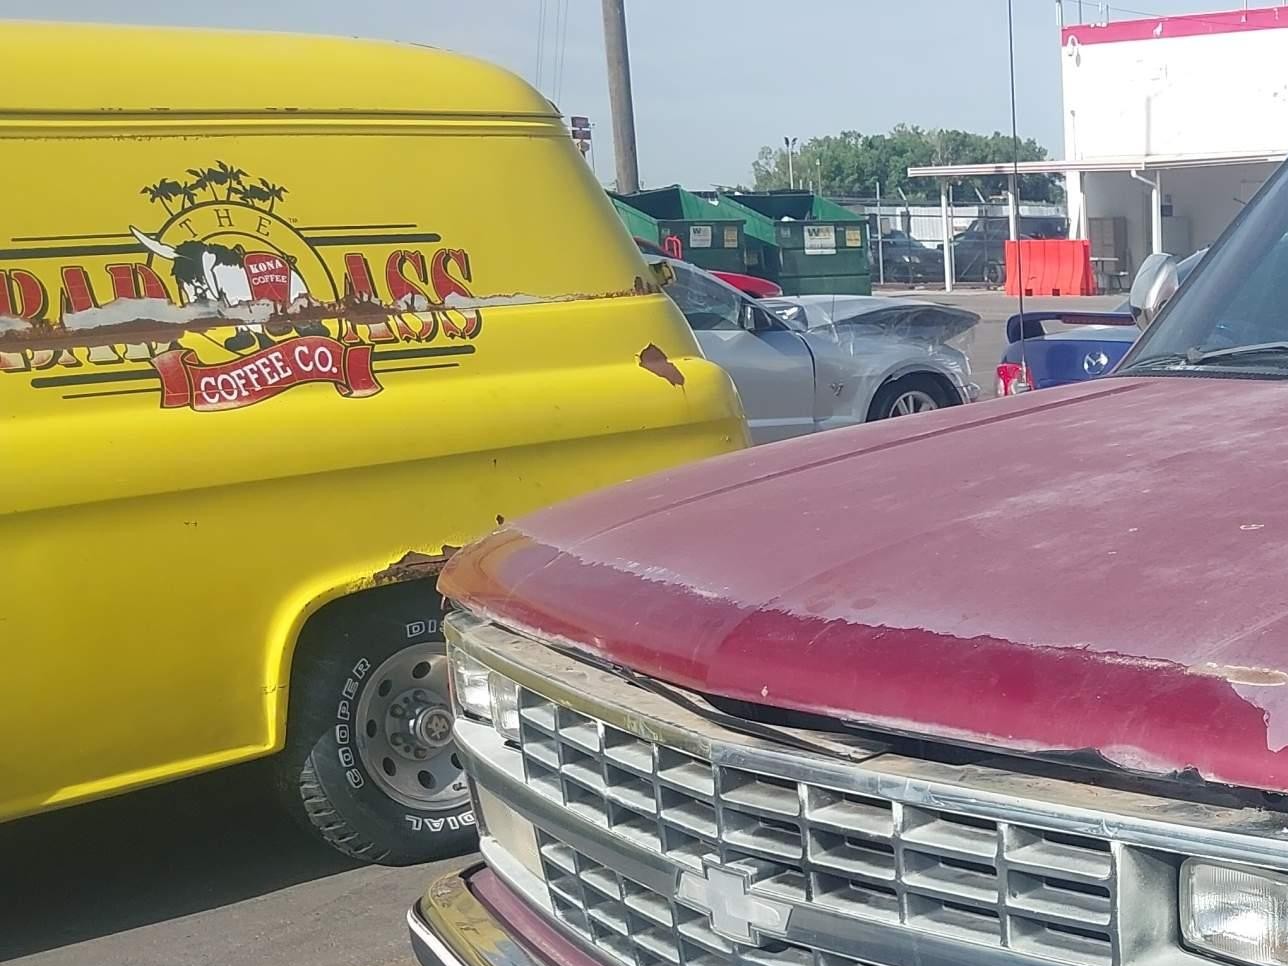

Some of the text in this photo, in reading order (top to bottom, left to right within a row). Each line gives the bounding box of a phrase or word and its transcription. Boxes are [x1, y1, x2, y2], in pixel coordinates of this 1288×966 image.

[179, 208, 271, 239] THE
[249, 259, 284, 274] KONA
[252, 274, 288, 286] COFFEE
[342, 248, 482, 343] ASS
[200, 345, 338, 404] COFFEE CO.
[336, 658, 371, 789] COOPER
